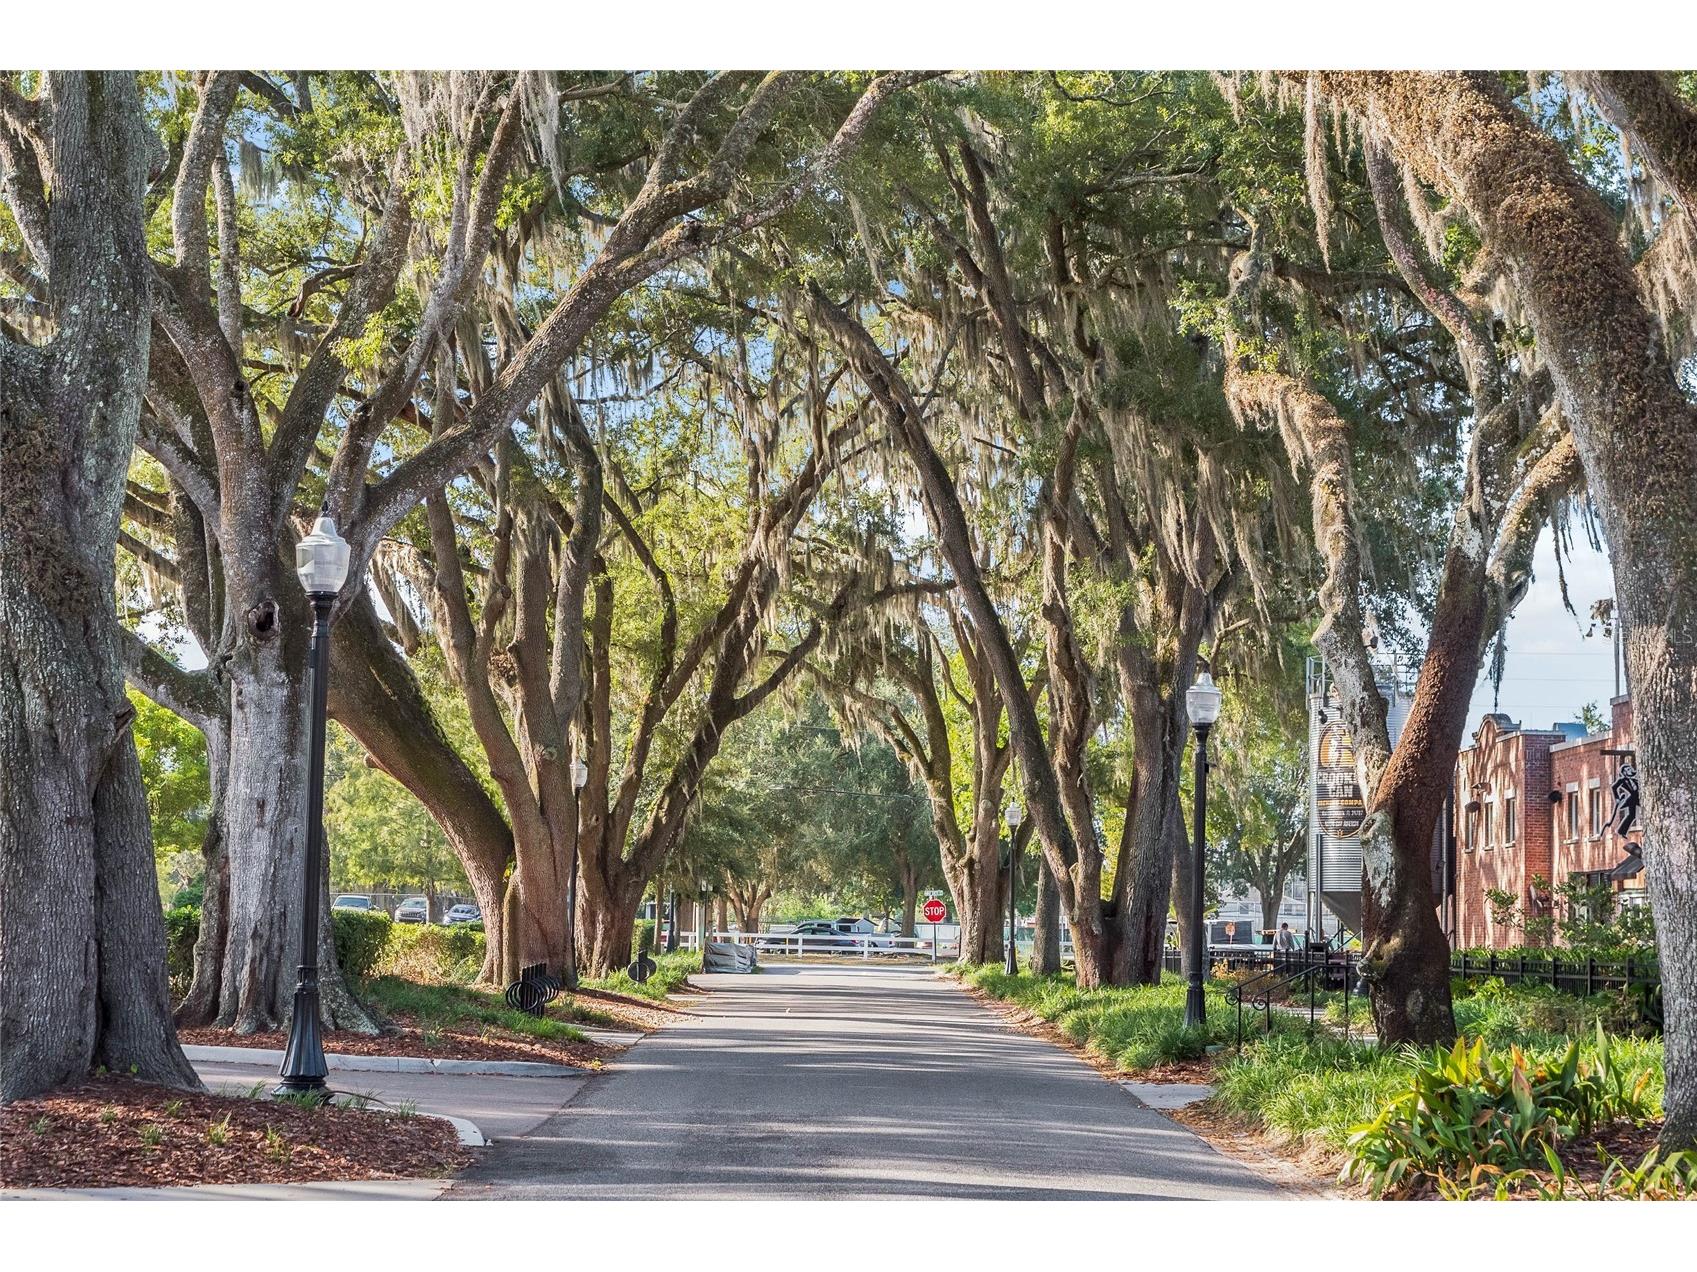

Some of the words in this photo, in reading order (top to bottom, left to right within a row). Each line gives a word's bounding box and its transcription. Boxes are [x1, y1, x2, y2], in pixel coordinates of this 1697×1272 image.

[1317, 772, 1358, 784] CROOKE
[1328, 785, 1353, 797] CAN
[925, 907, 945, 916] STOP
